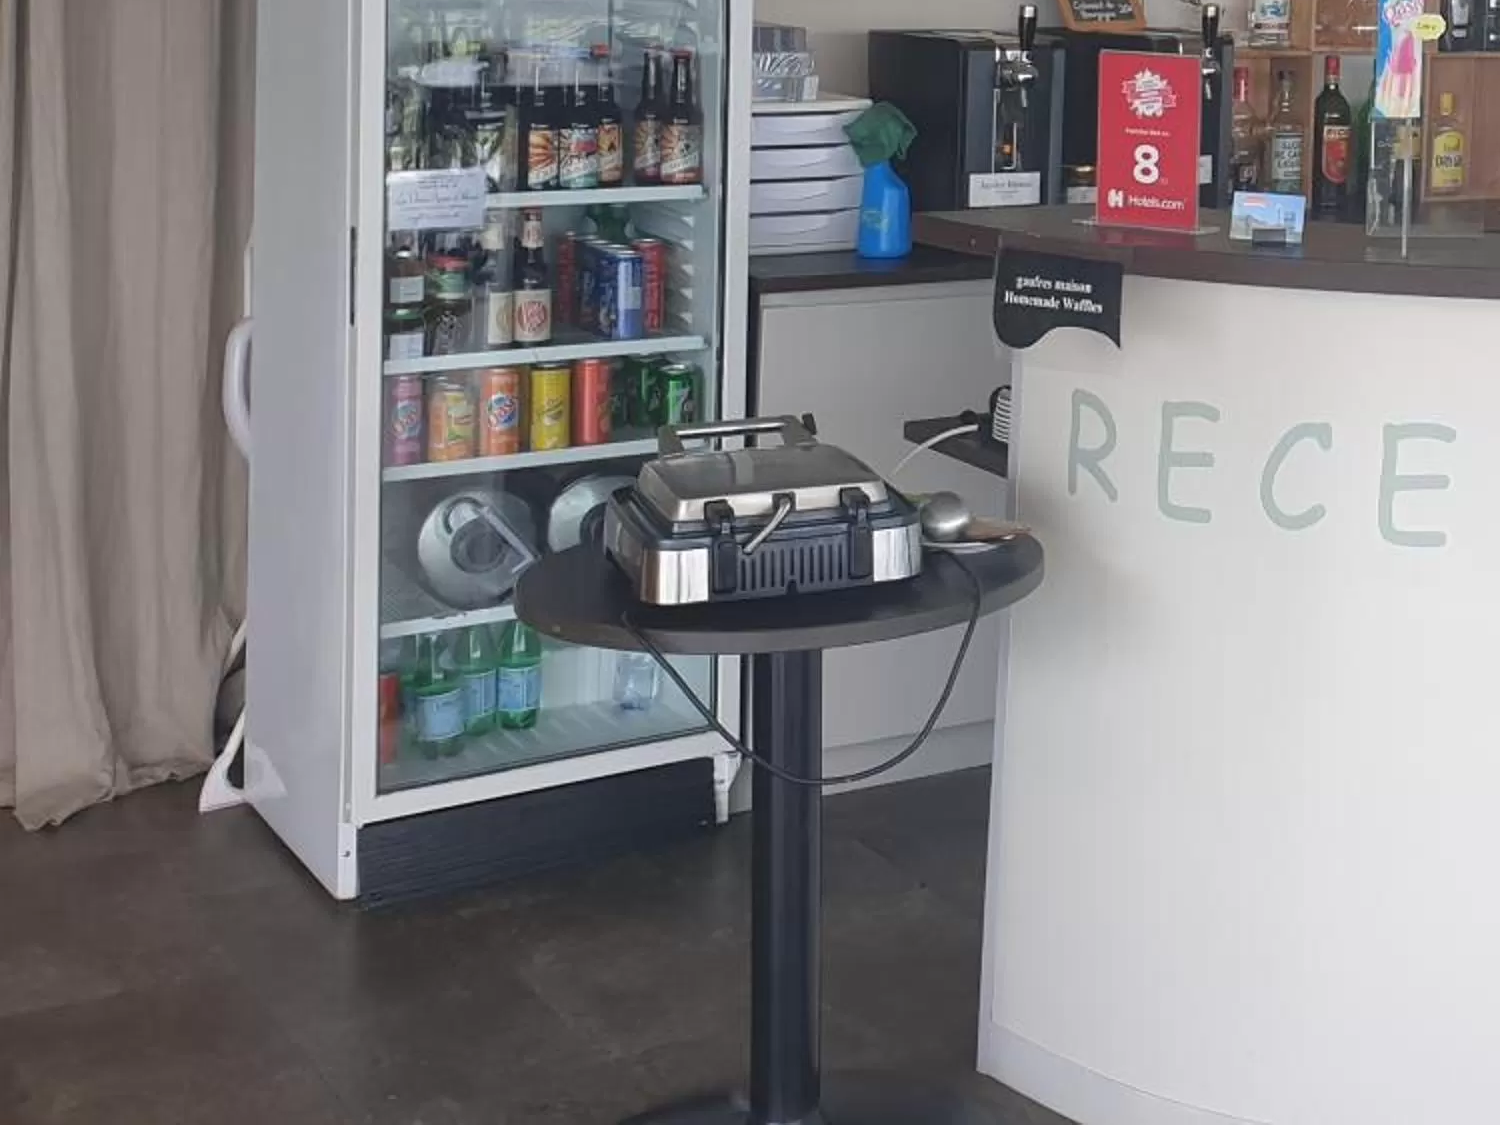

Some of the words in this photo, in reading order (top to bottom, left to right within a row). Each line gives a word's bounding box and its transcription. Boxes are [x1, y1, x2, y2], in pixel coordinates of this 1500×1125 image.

[1133, 144, 1160, 184] 8
[1128, 194, 1185, 210] Hotels.com
[1016, 276, 1052, 289] gaufres
[1054, 279, 1092, 293] maison
[1005, 290, 1060, 309] Homemade
[1063, 296, 1103, 313] Waffles
